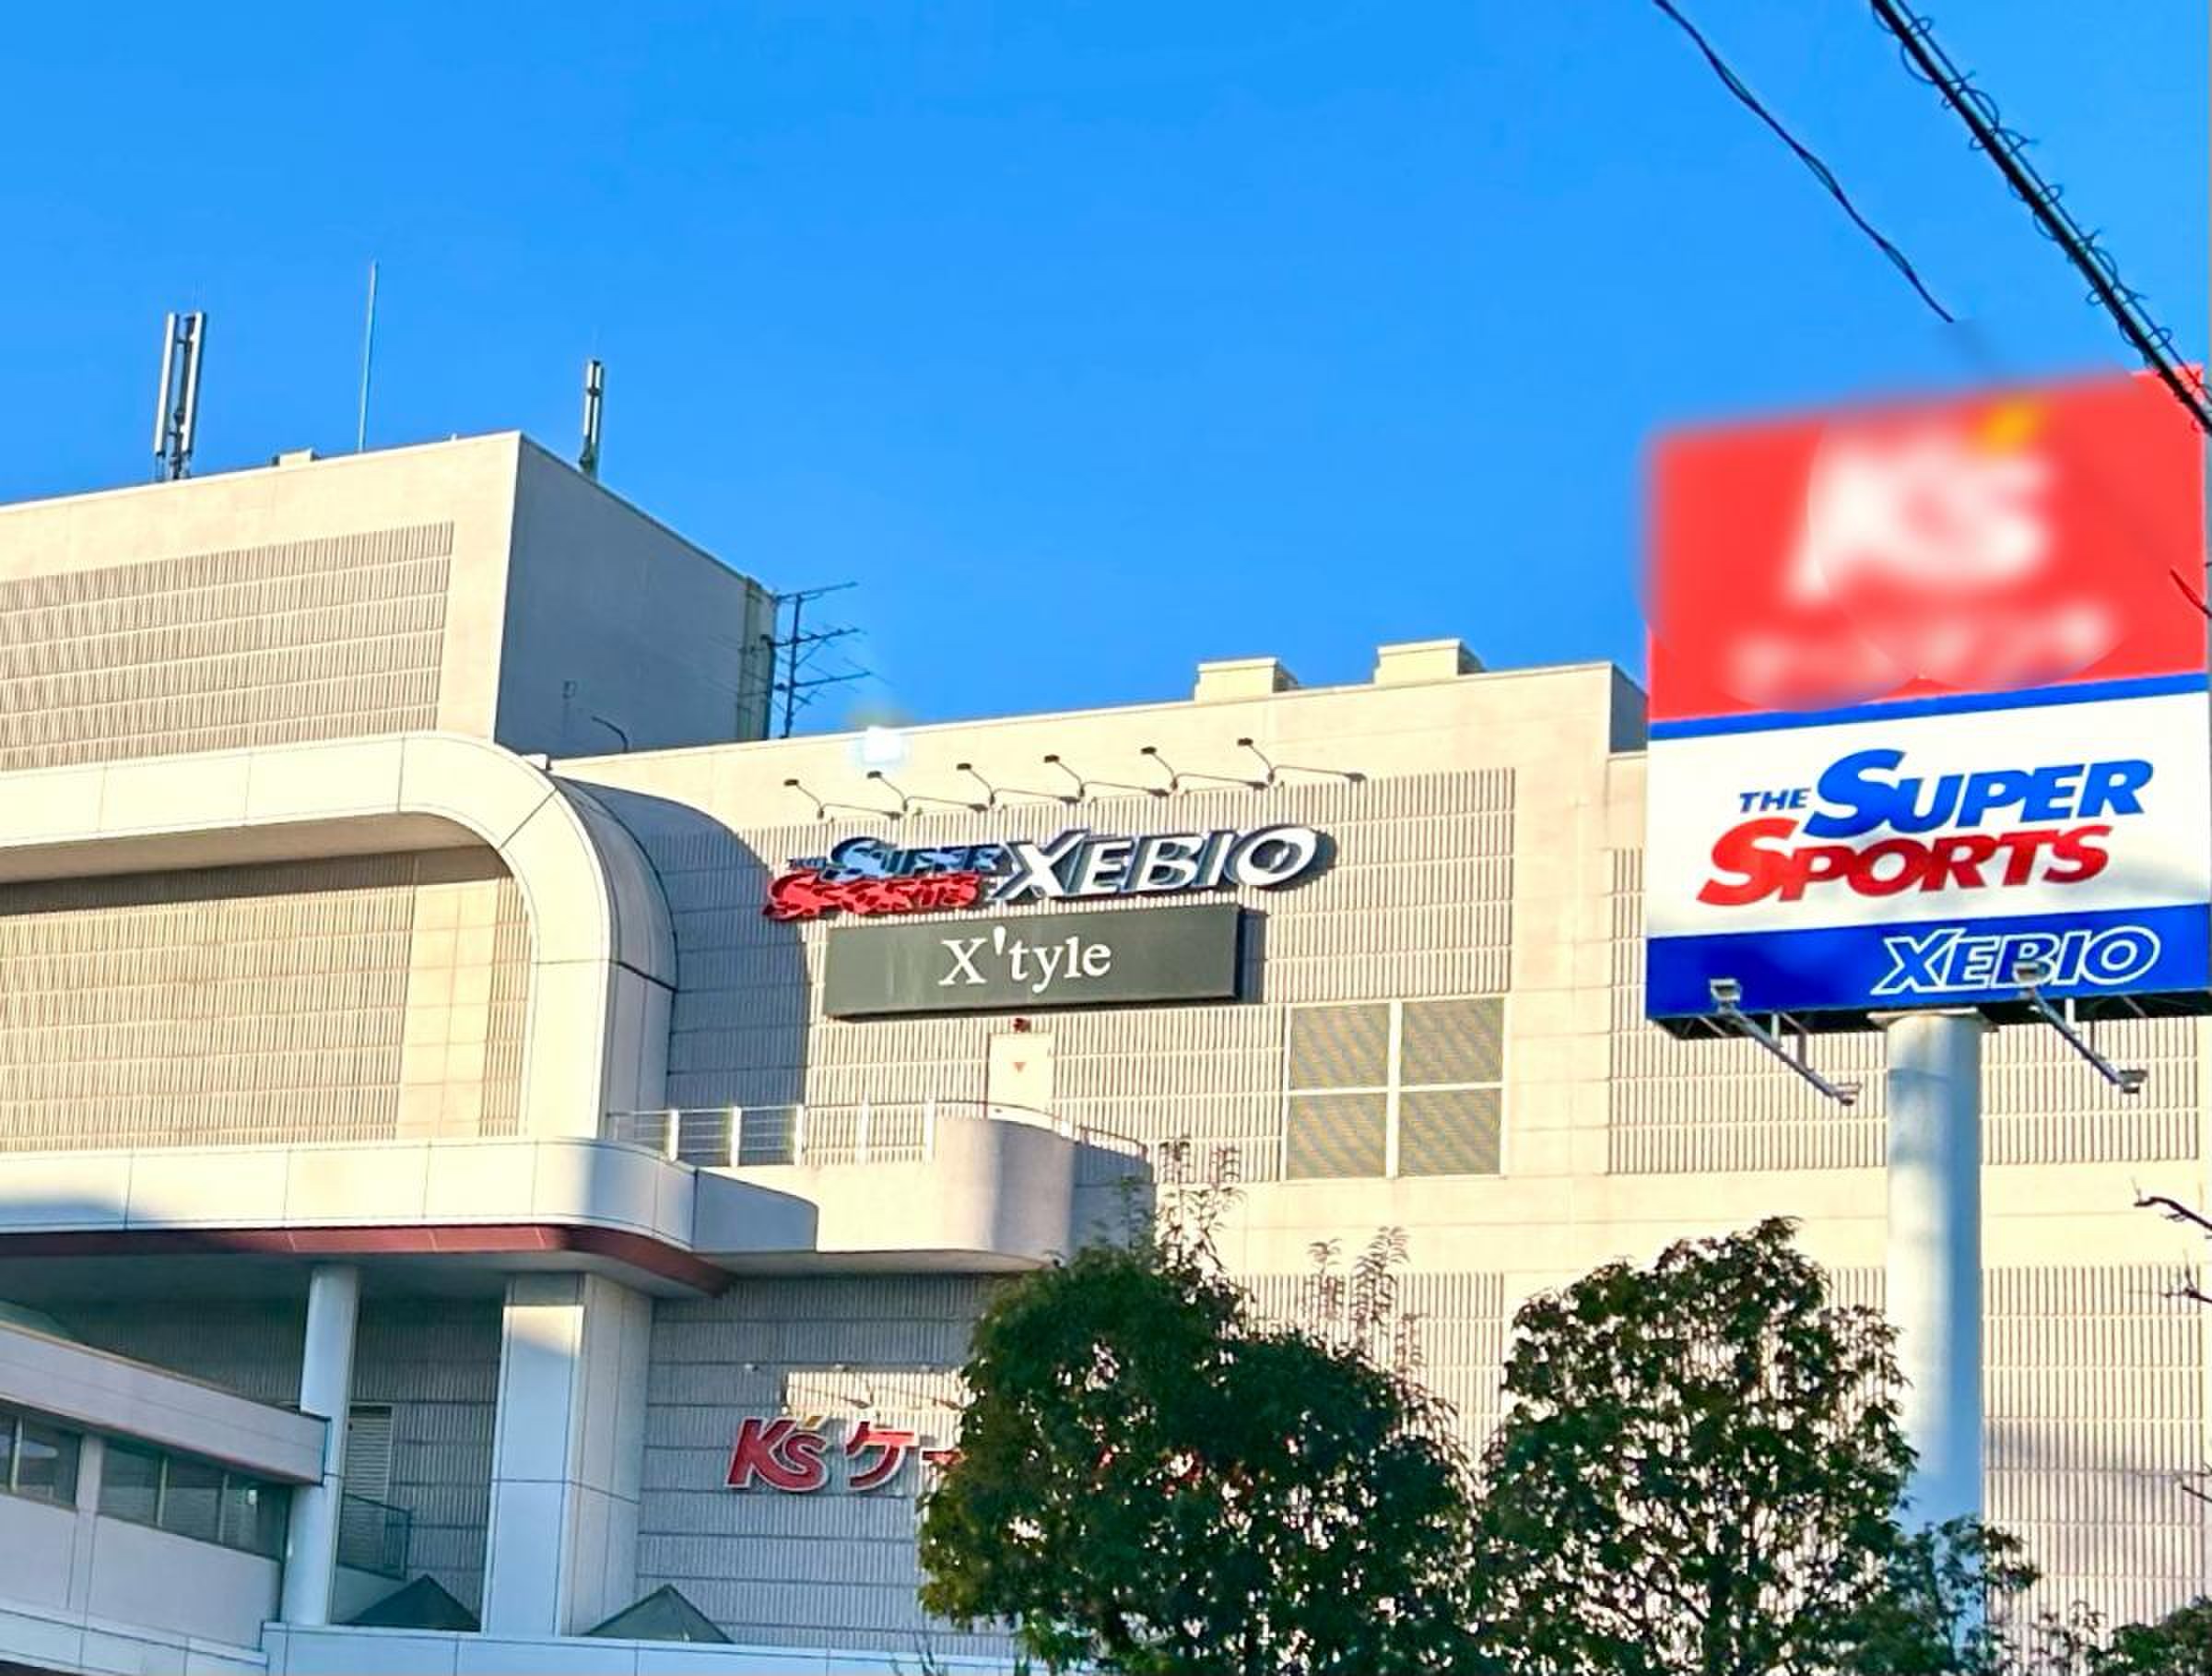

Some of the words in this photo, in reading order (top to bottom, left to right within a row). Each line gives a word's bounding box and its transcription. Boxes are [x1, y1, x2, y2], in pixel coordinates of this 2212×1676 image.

[1739, 787, 1812, 813] THE
[1804, 749, 2154, 839] SUPER
[993, 824, 1317, 901] XEBIO
[1696, 817, 2112, 906] SPORTS
[937, 927, 1112, 994] X'tyle
[1870, 925, 2161, 996] XEBIO
